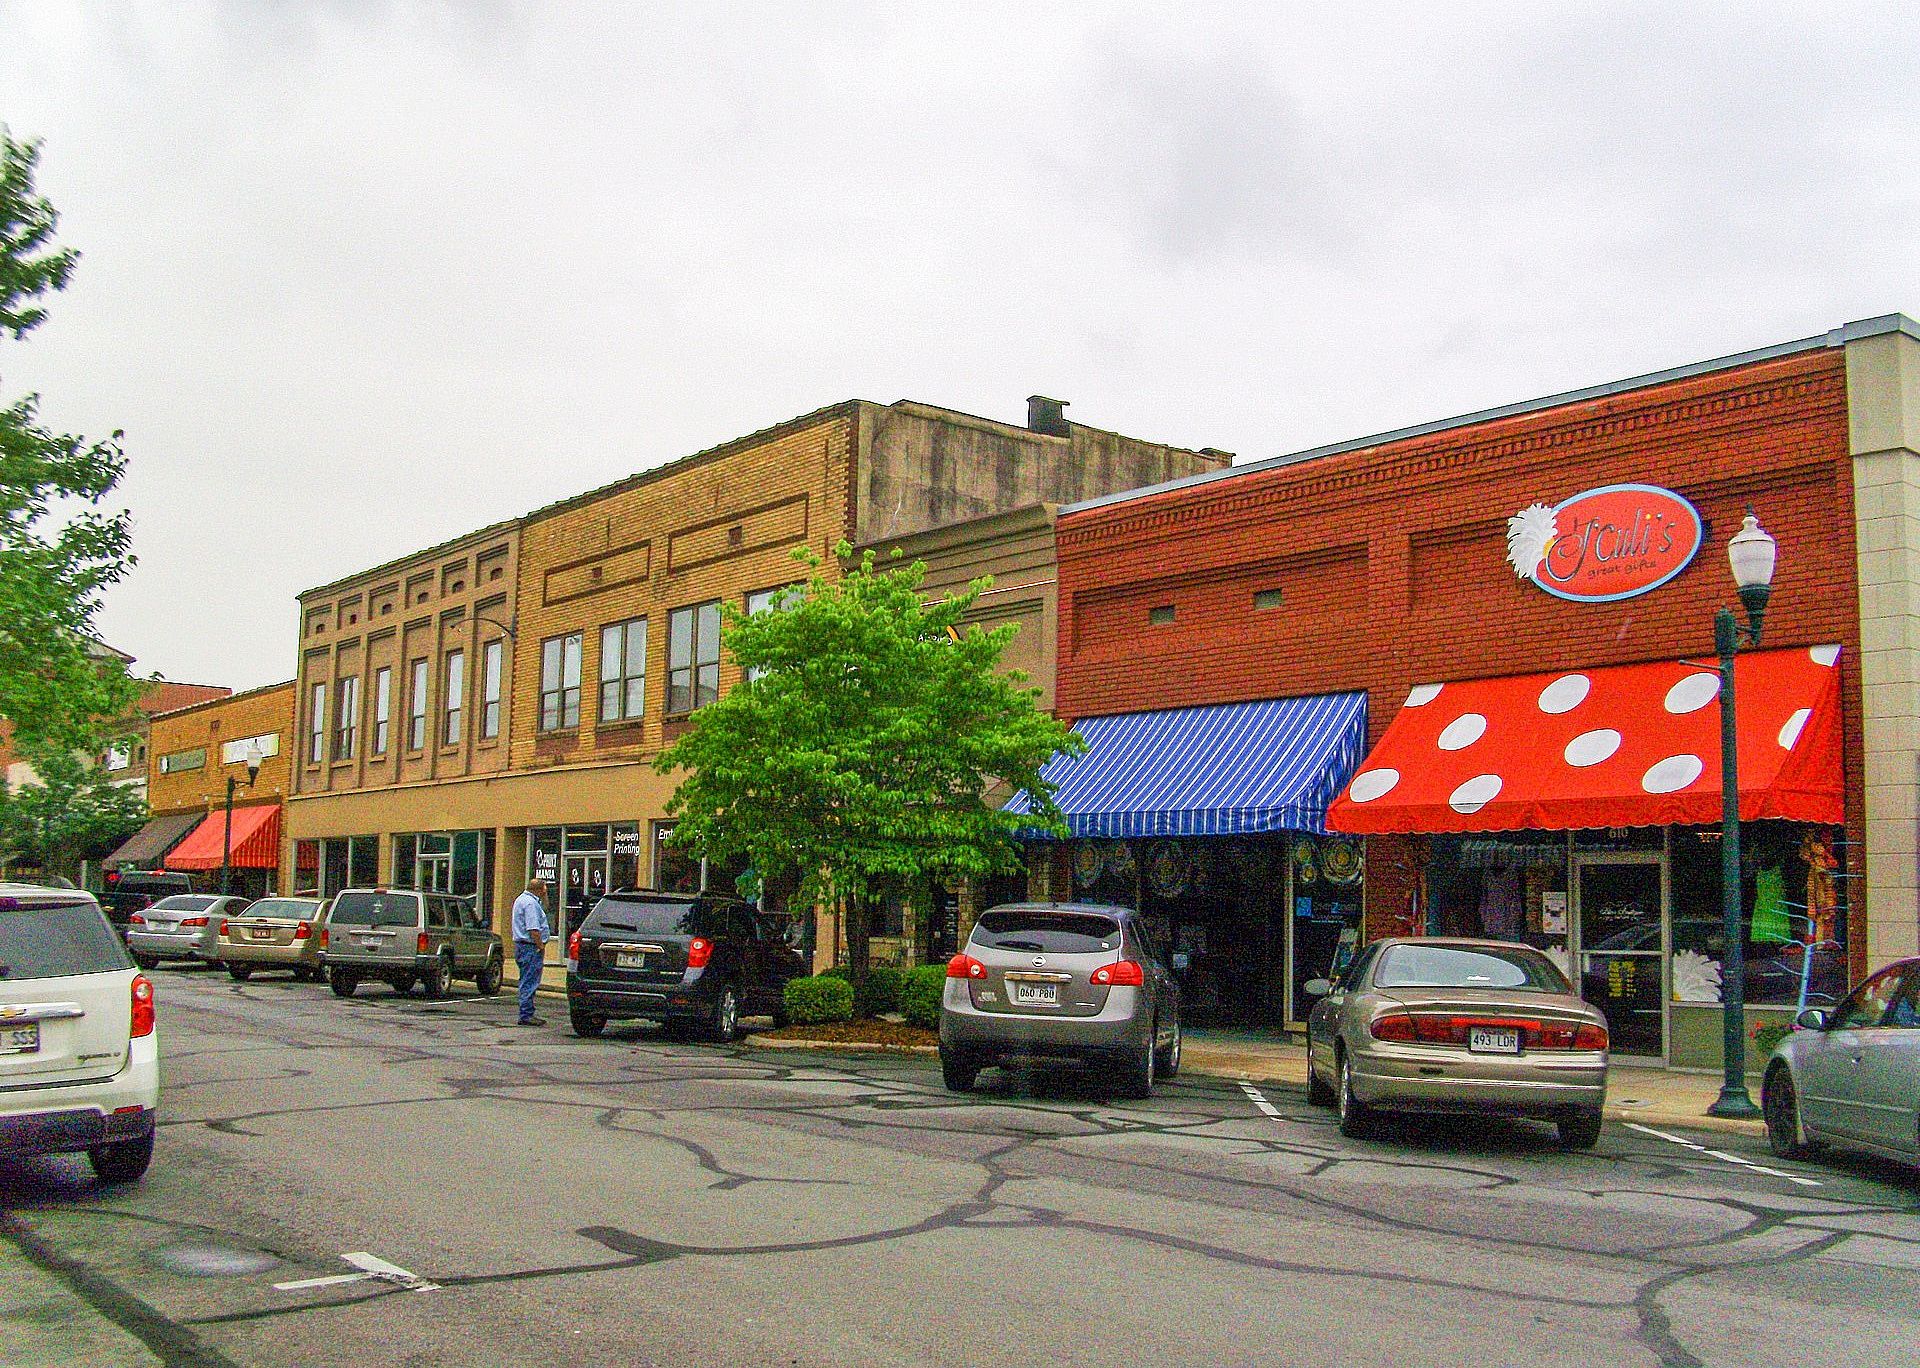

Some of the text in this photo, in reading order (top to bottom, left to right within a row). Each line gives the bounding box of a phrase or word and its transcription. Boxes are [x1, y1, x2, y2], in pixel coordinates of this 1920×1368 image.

[615, 831, 639, 842] Screen
[613, 843, 640, 856] Printing
[1473, 1034, 1492, 1046] 493
